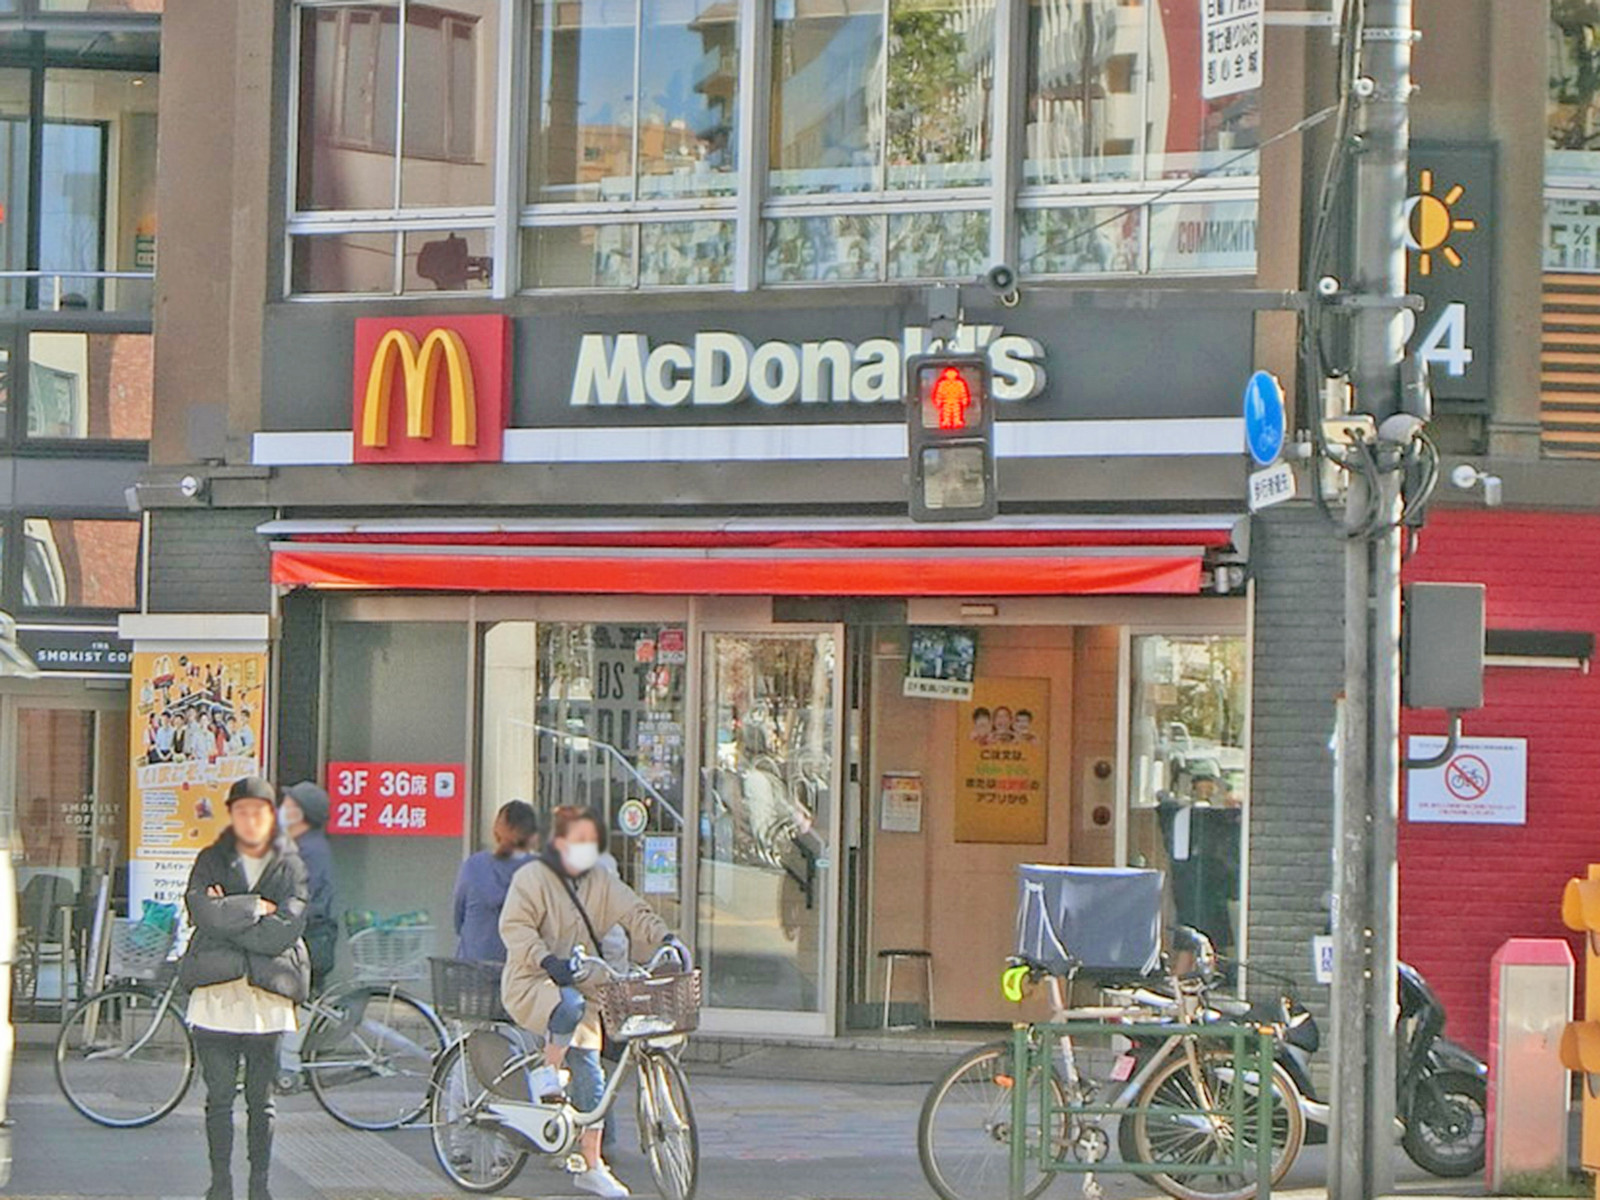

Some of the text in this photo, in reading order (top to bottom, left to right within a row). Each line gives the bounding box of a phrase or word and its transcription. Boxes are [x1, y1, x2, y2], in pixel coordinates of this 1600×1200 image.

[38, 650, 132, 663] SMOKIST CO
[338, 770, 428, 796] 3F 36席
[65, 815, 115, 824] COFEE
[337, 802, 427, 829] 2F 44席
